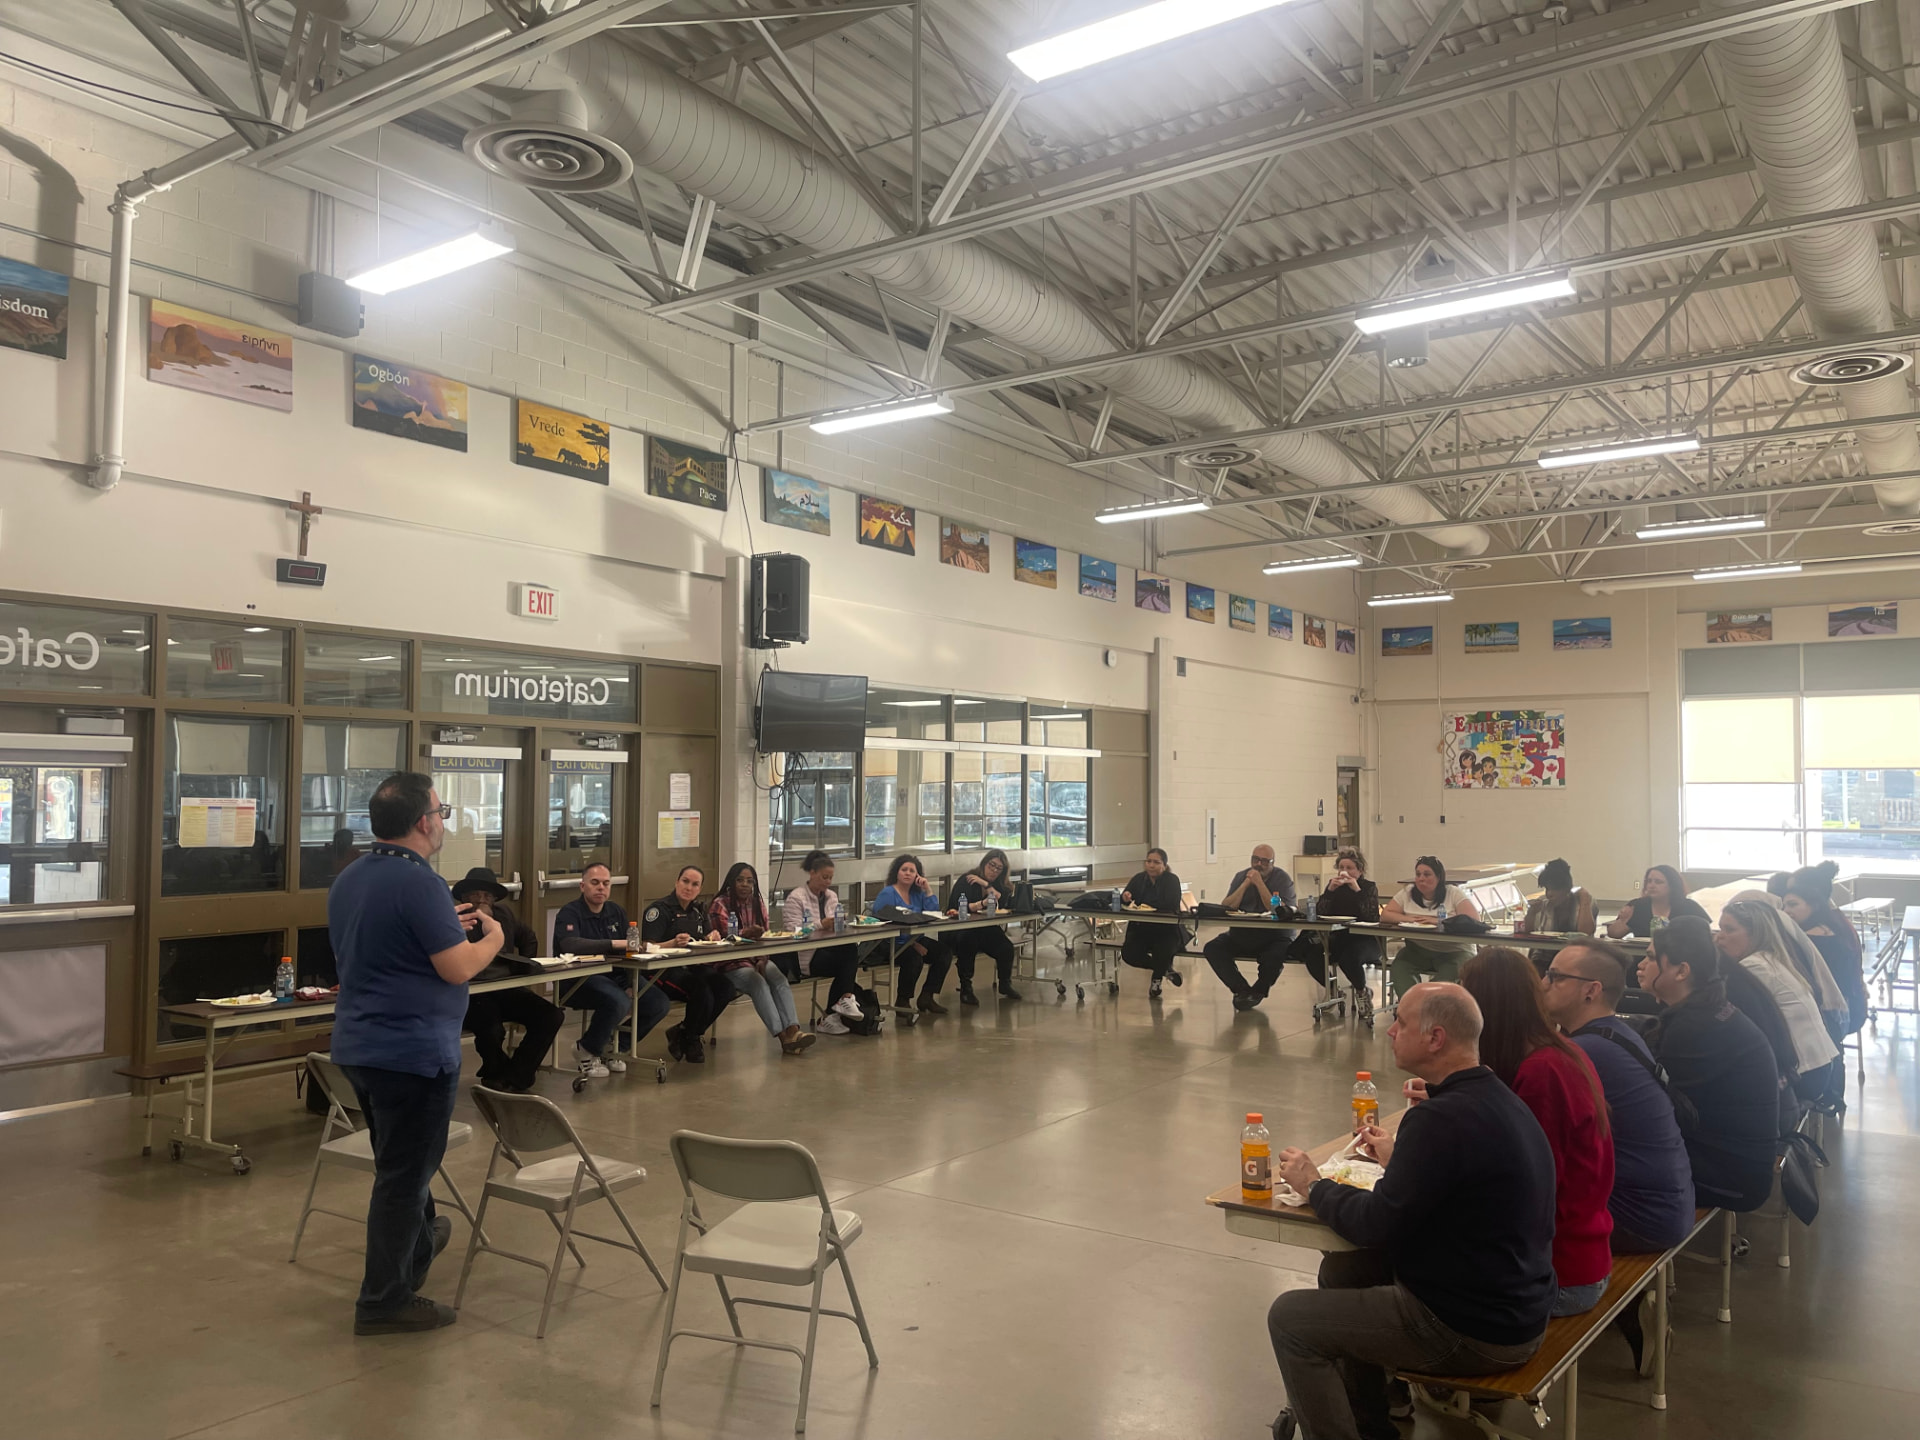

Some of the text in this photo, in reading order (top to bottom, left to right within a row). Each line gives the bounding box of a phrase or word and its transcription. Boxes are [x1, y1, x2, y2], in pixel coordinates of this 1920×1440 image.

[368, 365, 410, 387] Ogbón
[528, 413, 565, 436] Vrede
[800, 493, 820, 507] سلام
[529, 590, 554, 615] EXIT
[439, 757, 497, 768] EXIT ONLY
[1363, 1112, 1375, 1126] G
[1244, 1160, 1258, 1176] G
